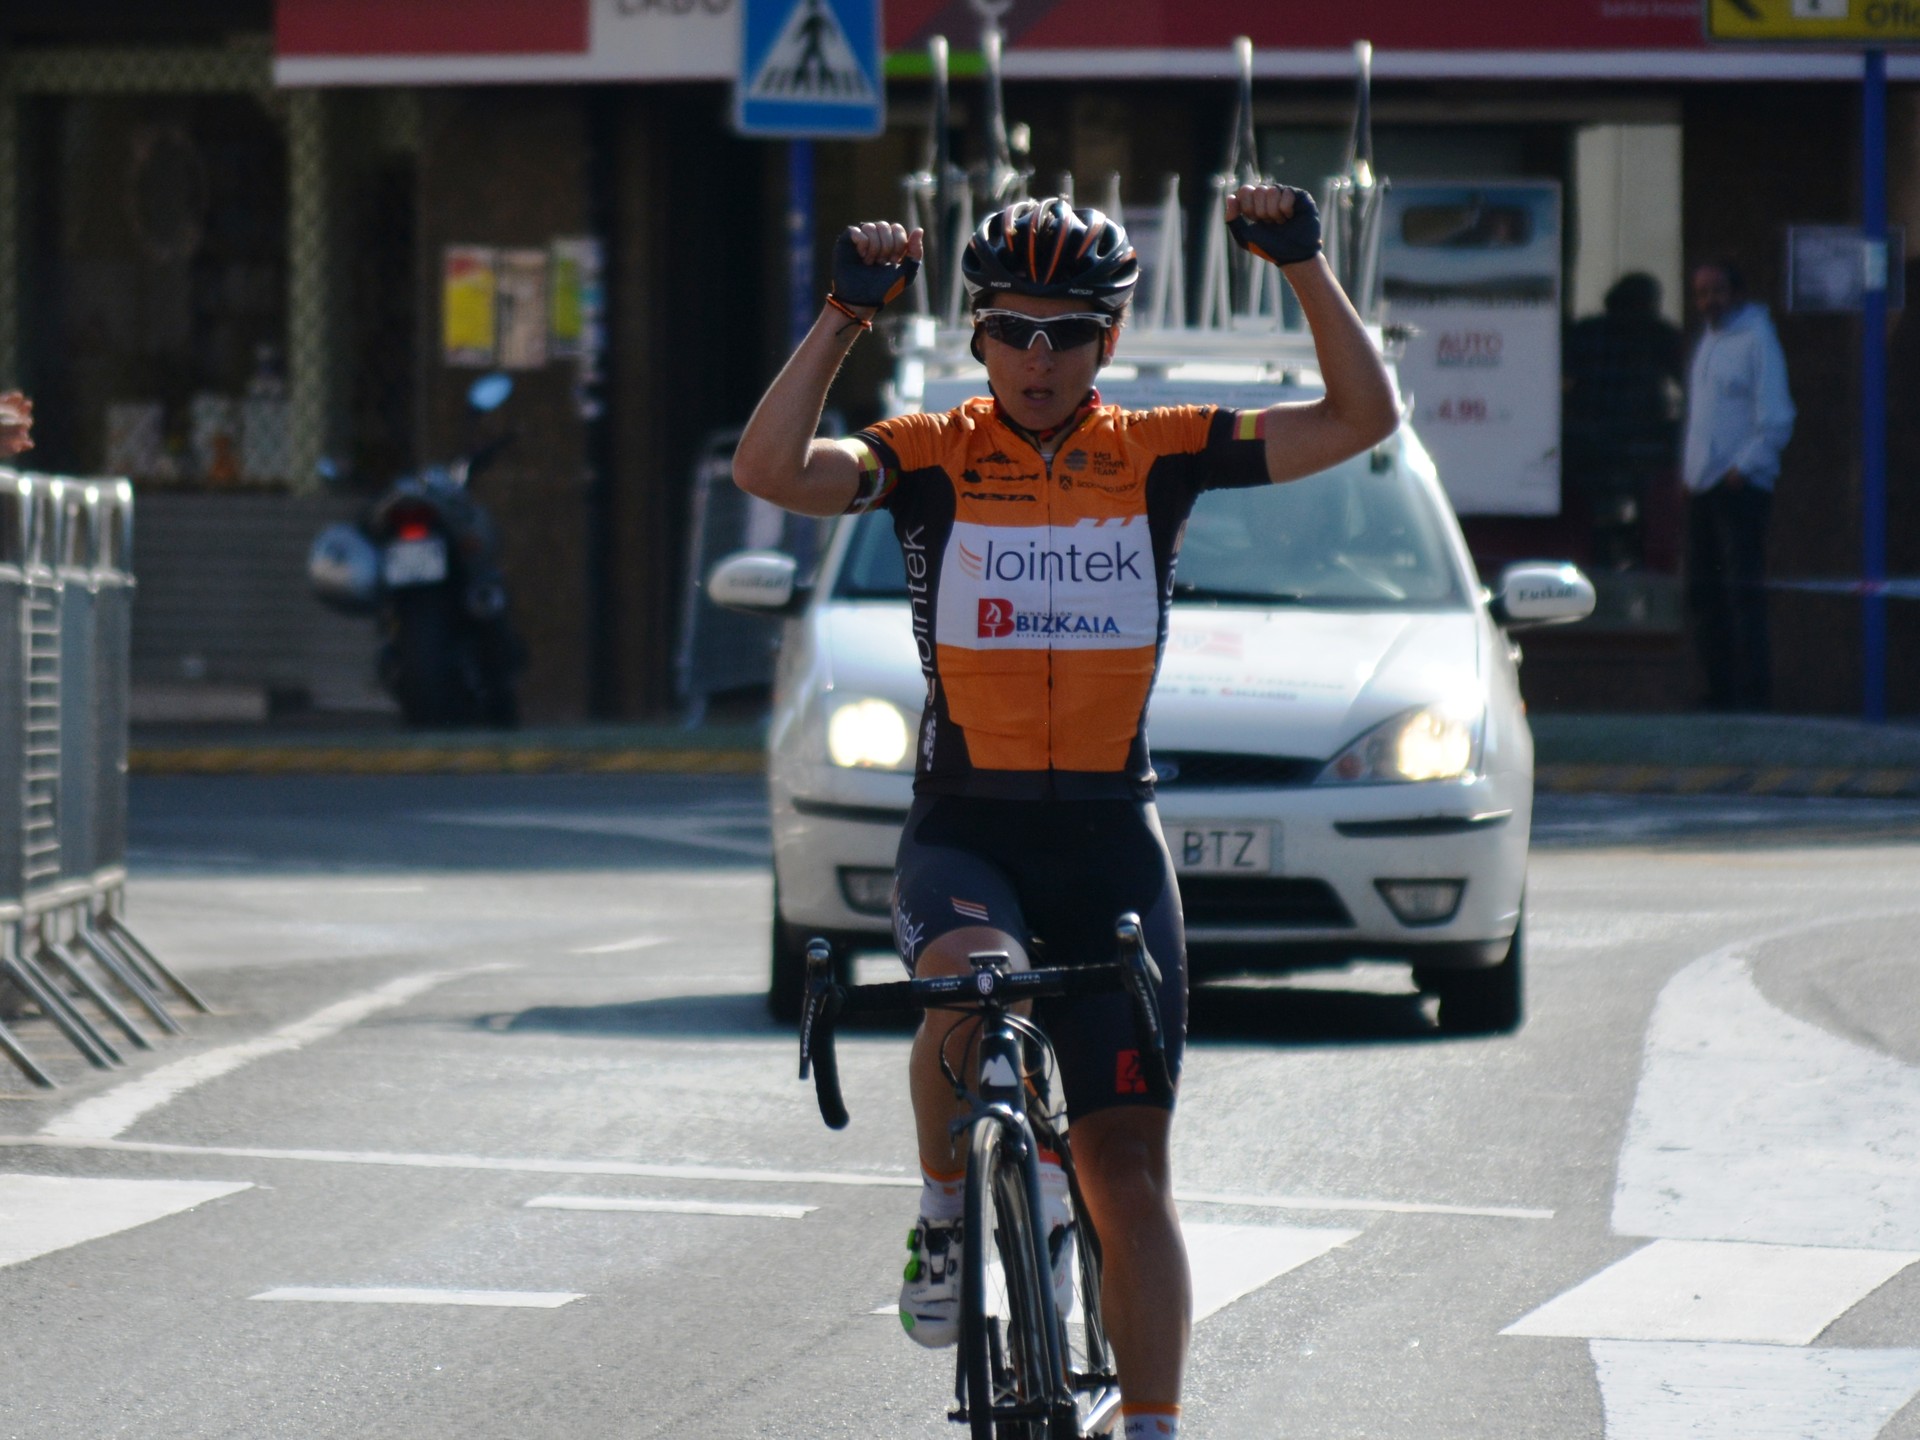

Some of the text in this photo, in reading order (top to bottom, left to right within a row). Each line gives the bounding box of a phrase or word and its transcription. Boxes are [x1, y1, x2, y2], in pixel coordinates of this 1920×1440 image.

[986, 540, 1141, 582] lointek
[1016, 615, 1121, 634] BIZKAIA
[1183, 831, 1256, 867] BTZ
